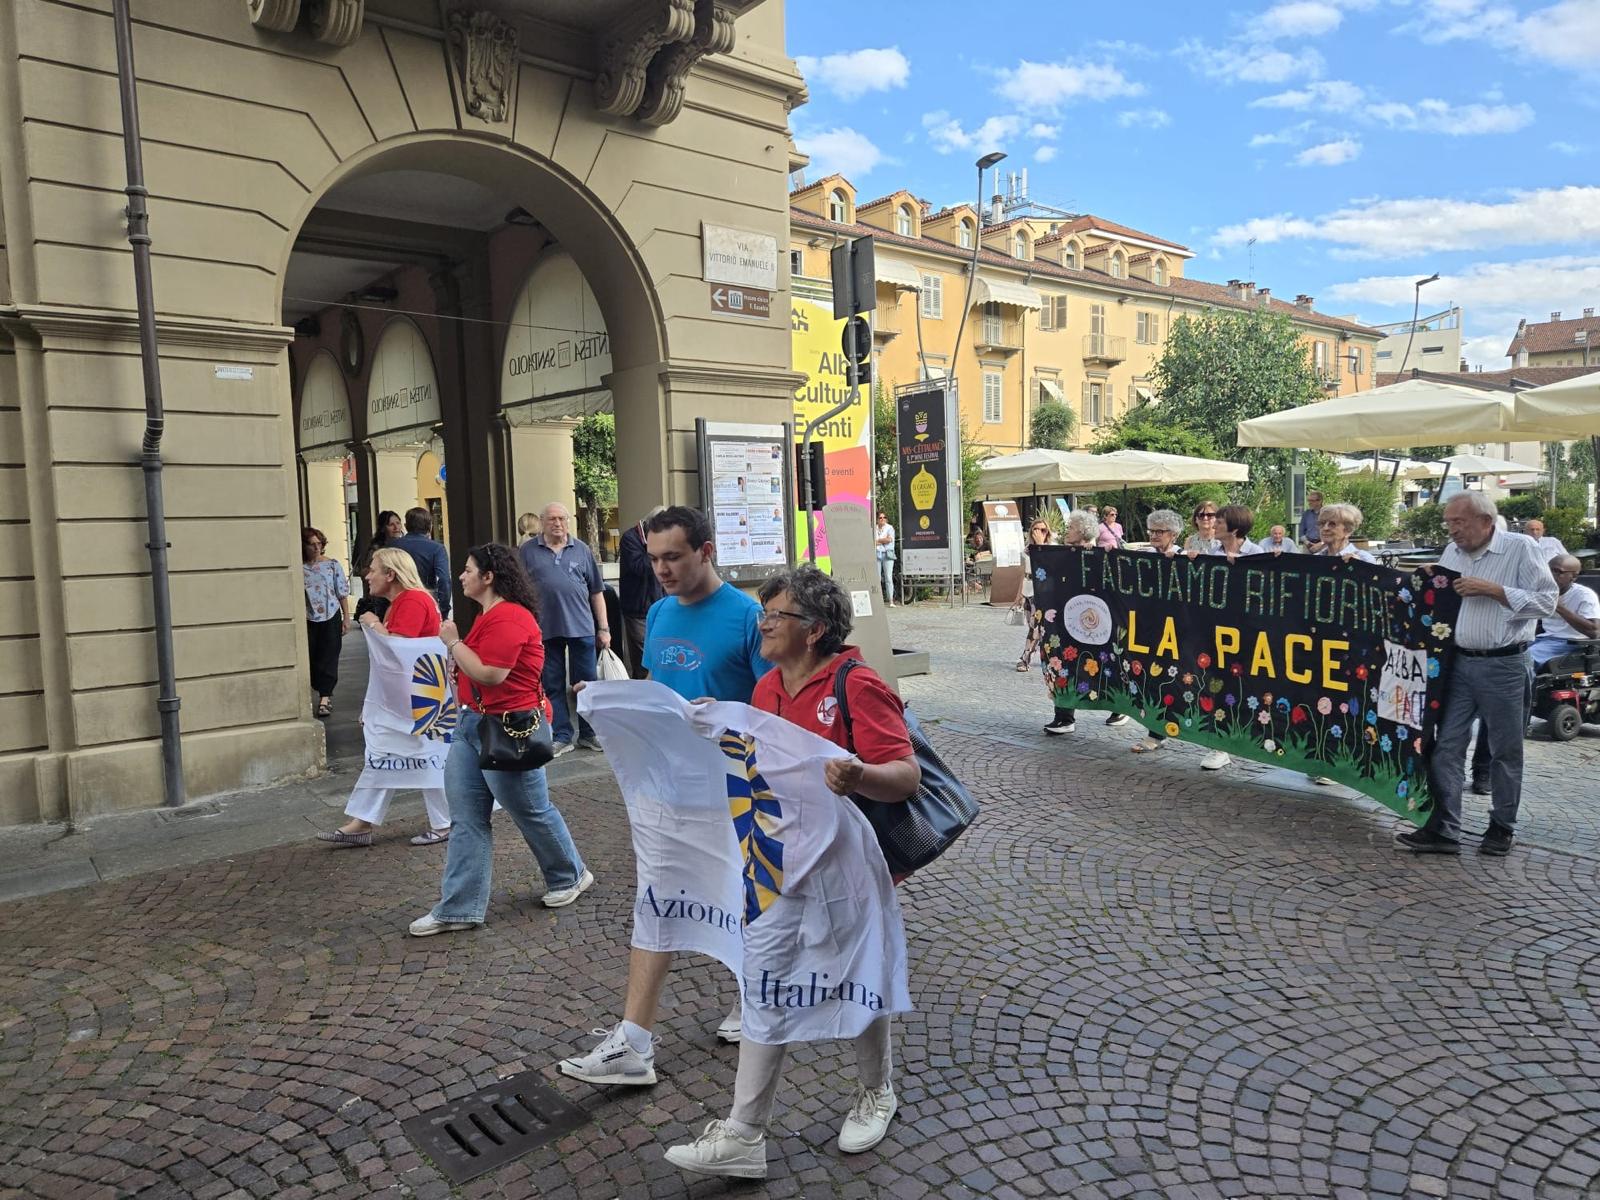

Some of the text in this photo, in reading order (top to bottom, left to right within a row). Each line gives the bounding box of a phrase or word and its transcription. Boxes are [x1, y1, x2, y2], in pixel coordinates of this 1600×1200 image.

[709, 252, 737, 265] VITTORIO
[739, 257, 769, 271] EMANUELE
[818, 352, 849, 376] Alb
[794, 381, 861, 405] Cultura
[831, 467, 855, 476] eventi
[1081, 550, 1399, 643] FACCIAMO RIFIORIRE
[1128, 610, 1350, 692] LA PACE
[1384, 647, 1425, 683] ALBA
[638, 884, 737, 935] Azione
[759, 968, 883, 1012] Italiana
